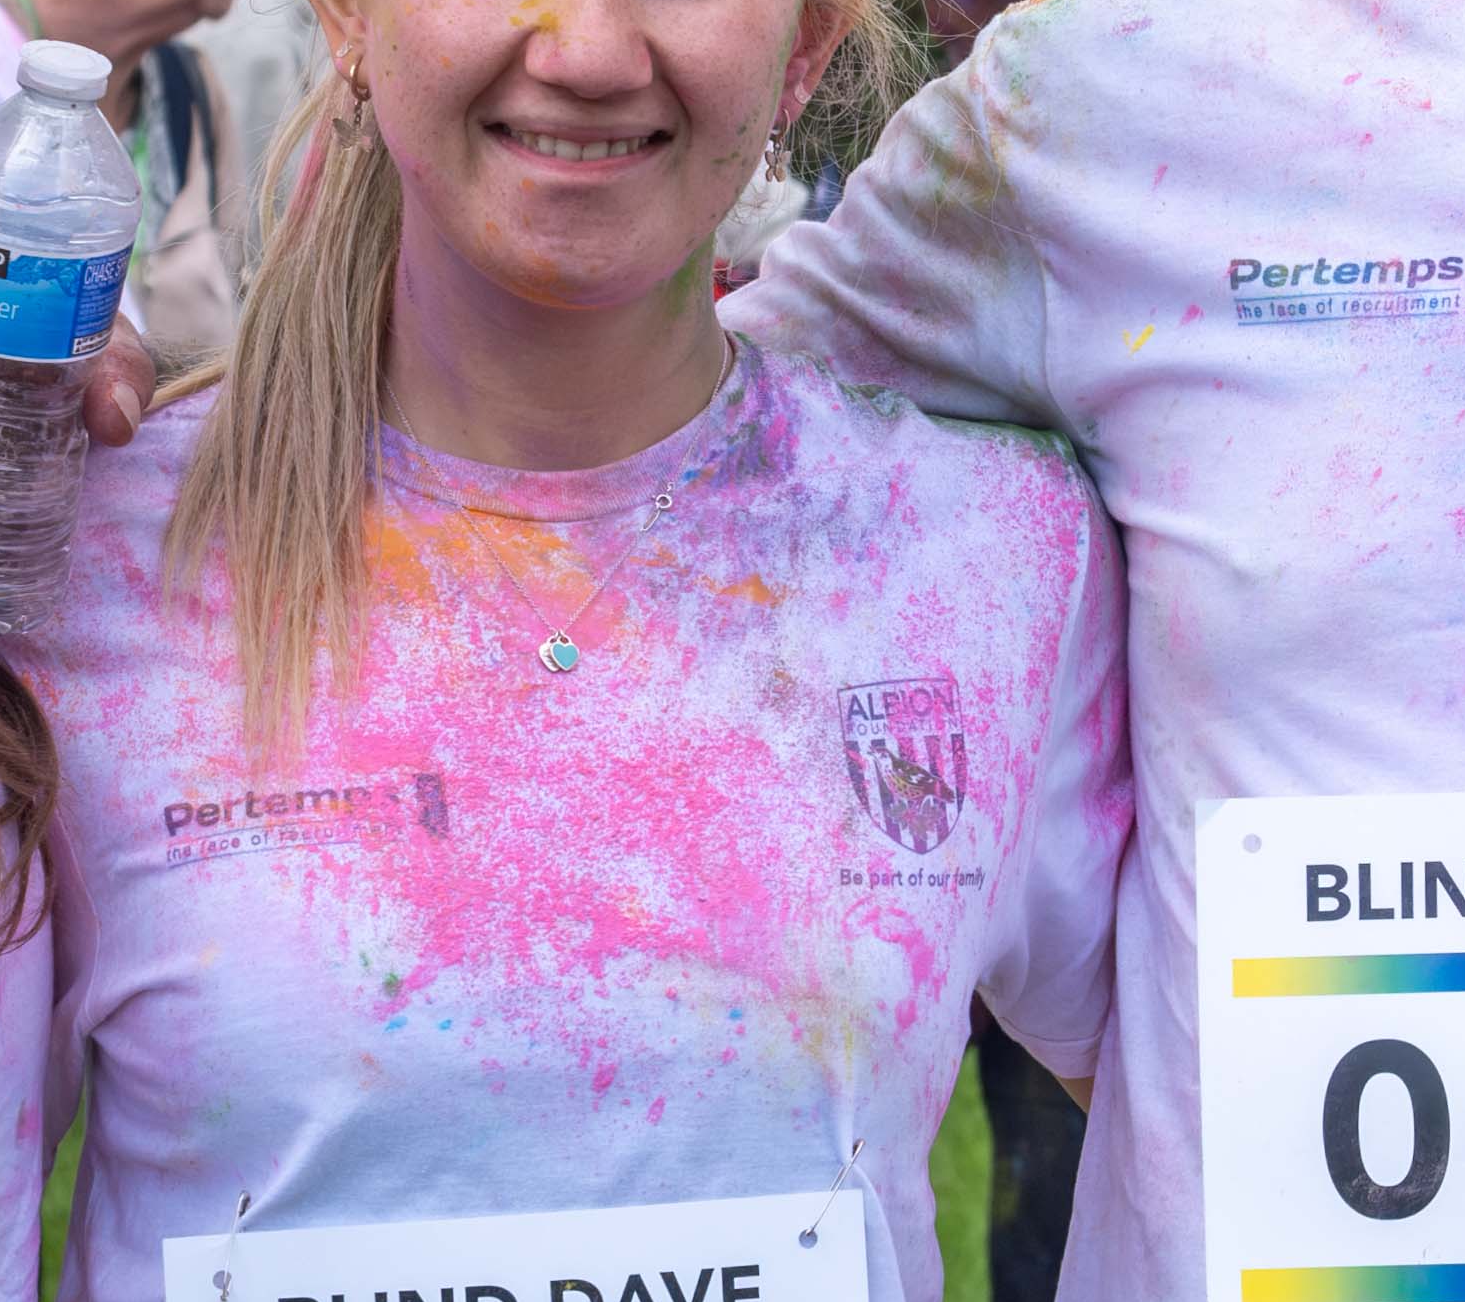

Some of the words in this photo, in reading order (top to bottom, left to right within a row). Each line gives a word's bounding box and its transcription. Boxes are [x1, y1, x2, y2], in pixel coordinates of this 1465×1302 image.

[1230, 255, 1464, 290] Pertemps
[1237, 304, 1263, 319] the
[1269, 302, 1307, 317] face
[1316, 300, 1333, 315] of
[1342, 295, 1461, 314] recruitment
[164, 785, 396, 836] Pertemp
[840, 868, 863, 886] Be
[870, 869, 903, 889] part
[908, 868, 924, 886] of
[927, 872, 951, 886] our
[954, 866, 986, 889] family
